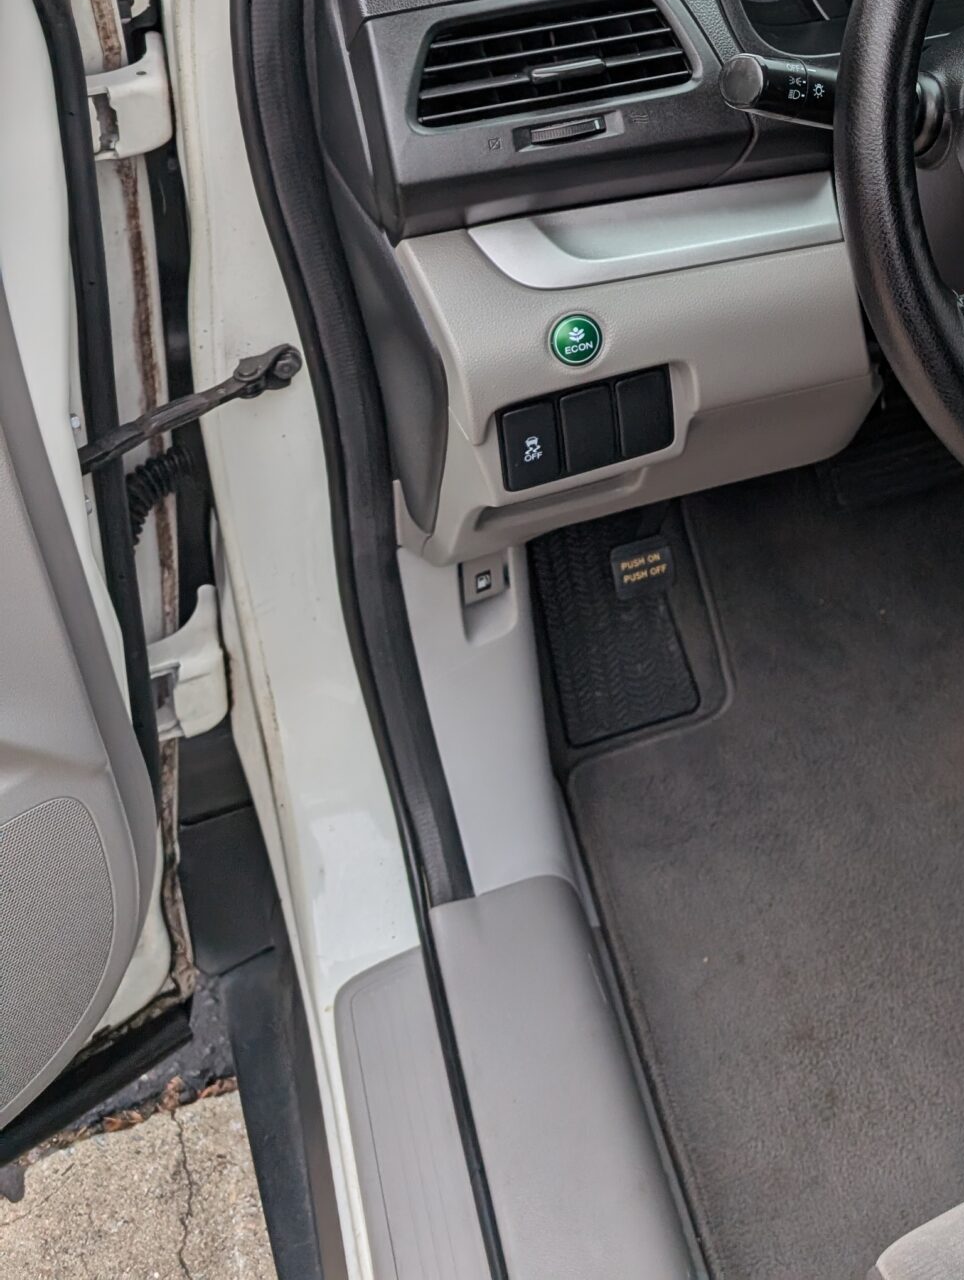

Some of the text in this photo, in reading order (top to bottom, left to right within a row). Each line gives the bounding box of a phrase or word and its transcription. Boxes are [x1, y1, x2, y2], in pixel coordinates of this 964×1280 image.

[786, 63, 801, 73] OFF
[564, 341, 594, 355] ECON
[524, 451, 543, 463] OFF
[621, 551, 661, 571] PUSH ON
[623, 563, 667, 584] PUSH OFF
